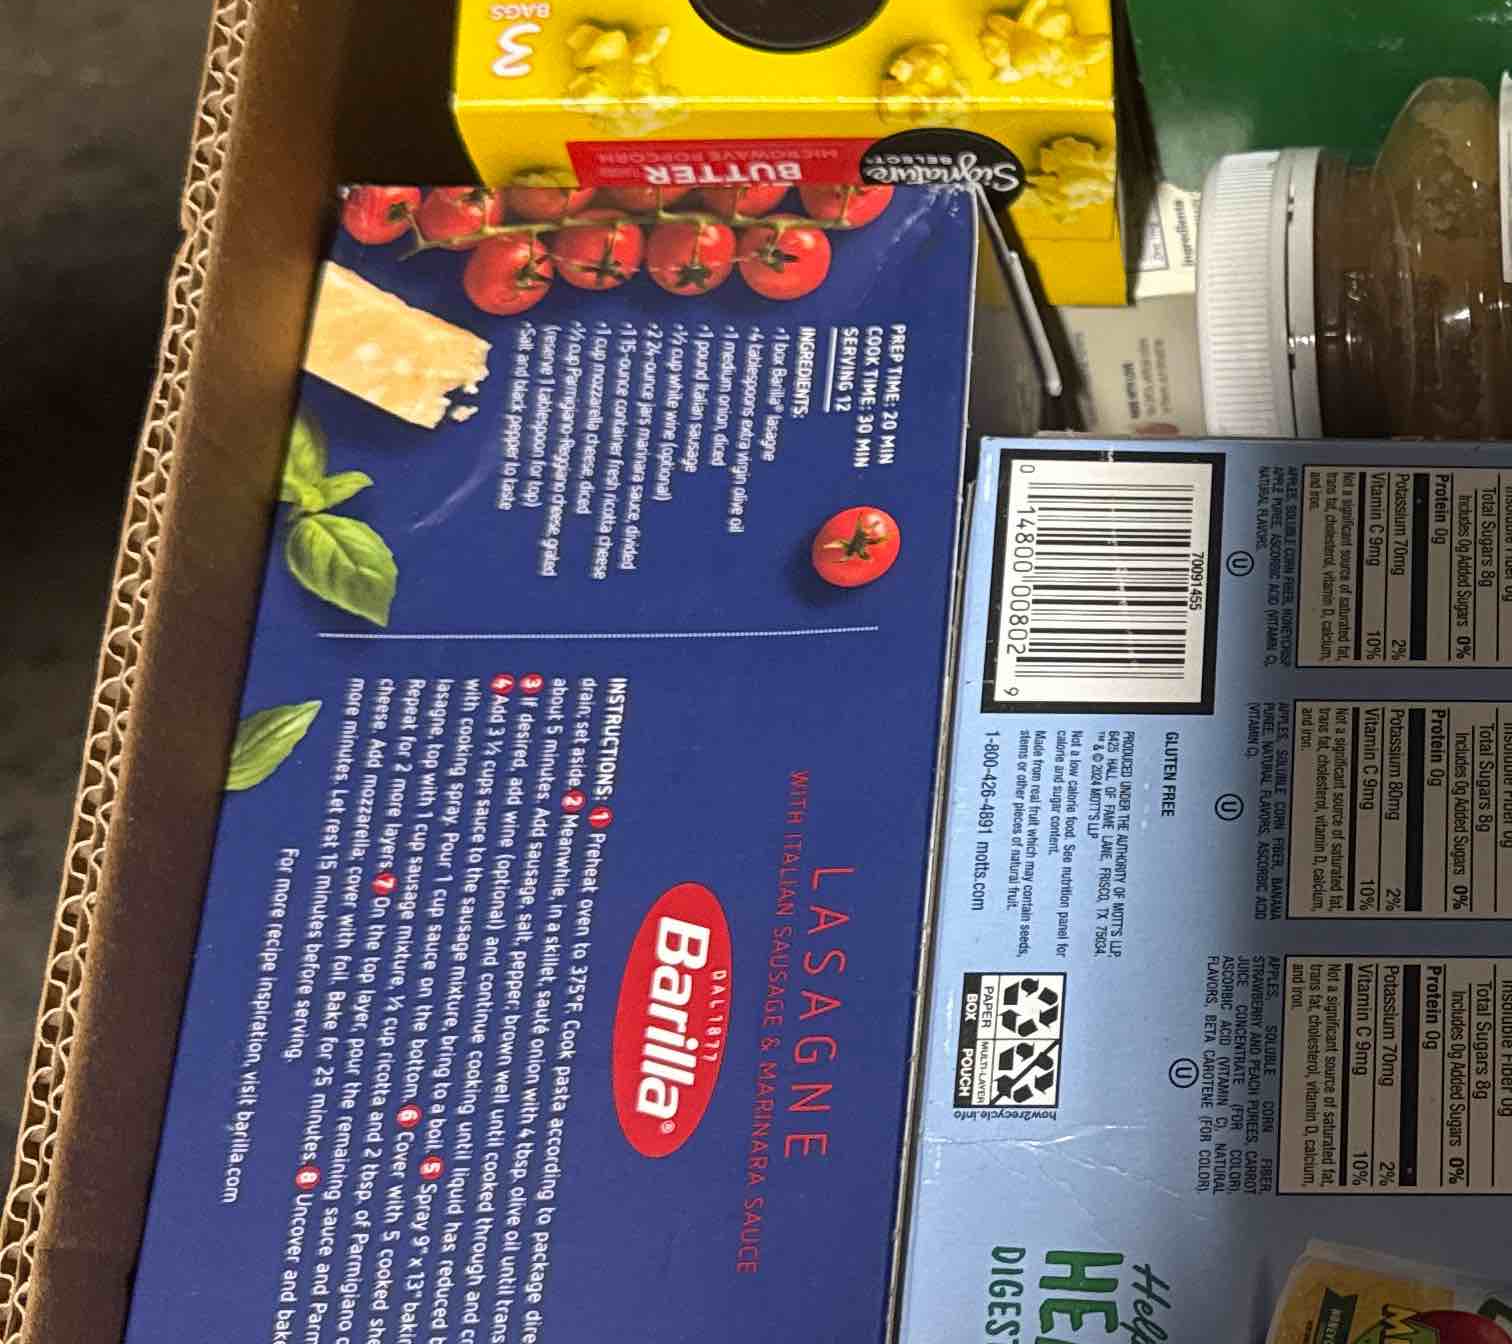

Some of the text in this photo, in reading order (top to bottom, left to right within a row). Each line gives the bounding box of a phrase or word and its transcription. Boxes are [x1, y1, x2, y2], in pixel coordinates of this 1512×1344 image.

[488, 2, 551, 20] BAGS
[490, 24, 541, 78] 3
[642, 159, 801, 186] BUTTER
[864, 155, 1021, 192] Signature
[791, 327, 817, 419] INGREDIENTS:
[835, 326, 859, 413] SERVING 12
[853, 326, 884, 468] COOK TIME: 30 MIN
[879, 324, 907, 465] PREP TIME: 20 MIN
[1006, 506, 1034, 655] 14800 00802
[1188, 552, 1205, 611] 70091455
[592, 677, 628, 801] INSTRUCTIONS:
[1160, 731, 1180, 817] GLUTEN FREE
[970, 730, 999, 911] 1-800-426-4891 motts.com
[581, 833, 606, 894] Preheat
[572, 943, 590, 959] to
[575, 899, 594, 937] oven
[222, 848, 300, 1204] For more recipe inspiration, visit barilla.com
[558, 1019, 581, 1060] Cook
[636, 915, 712, 1120] Barilla
[703, 968, 729, 1063] DAL 1877
[736, 770, 810, 1274] WITH ITALIAN SAUSAGE & MARINARA SAUCE
[782, 865, 856, 1159] LASAGNE
[963, 993, 979, 1022] BOX
[981, 985, 994, 1029] PAPER
[550, 1066, 572, 1112] pasta
[958, 1048, 974, 1097] POUCH
[953, 1109, 1057, 1122] how2recycle.info
[536, 1118, 567, 1201] according
[537, 1207, 556, 1225] to
[524, 1231, 552, 1304] package
